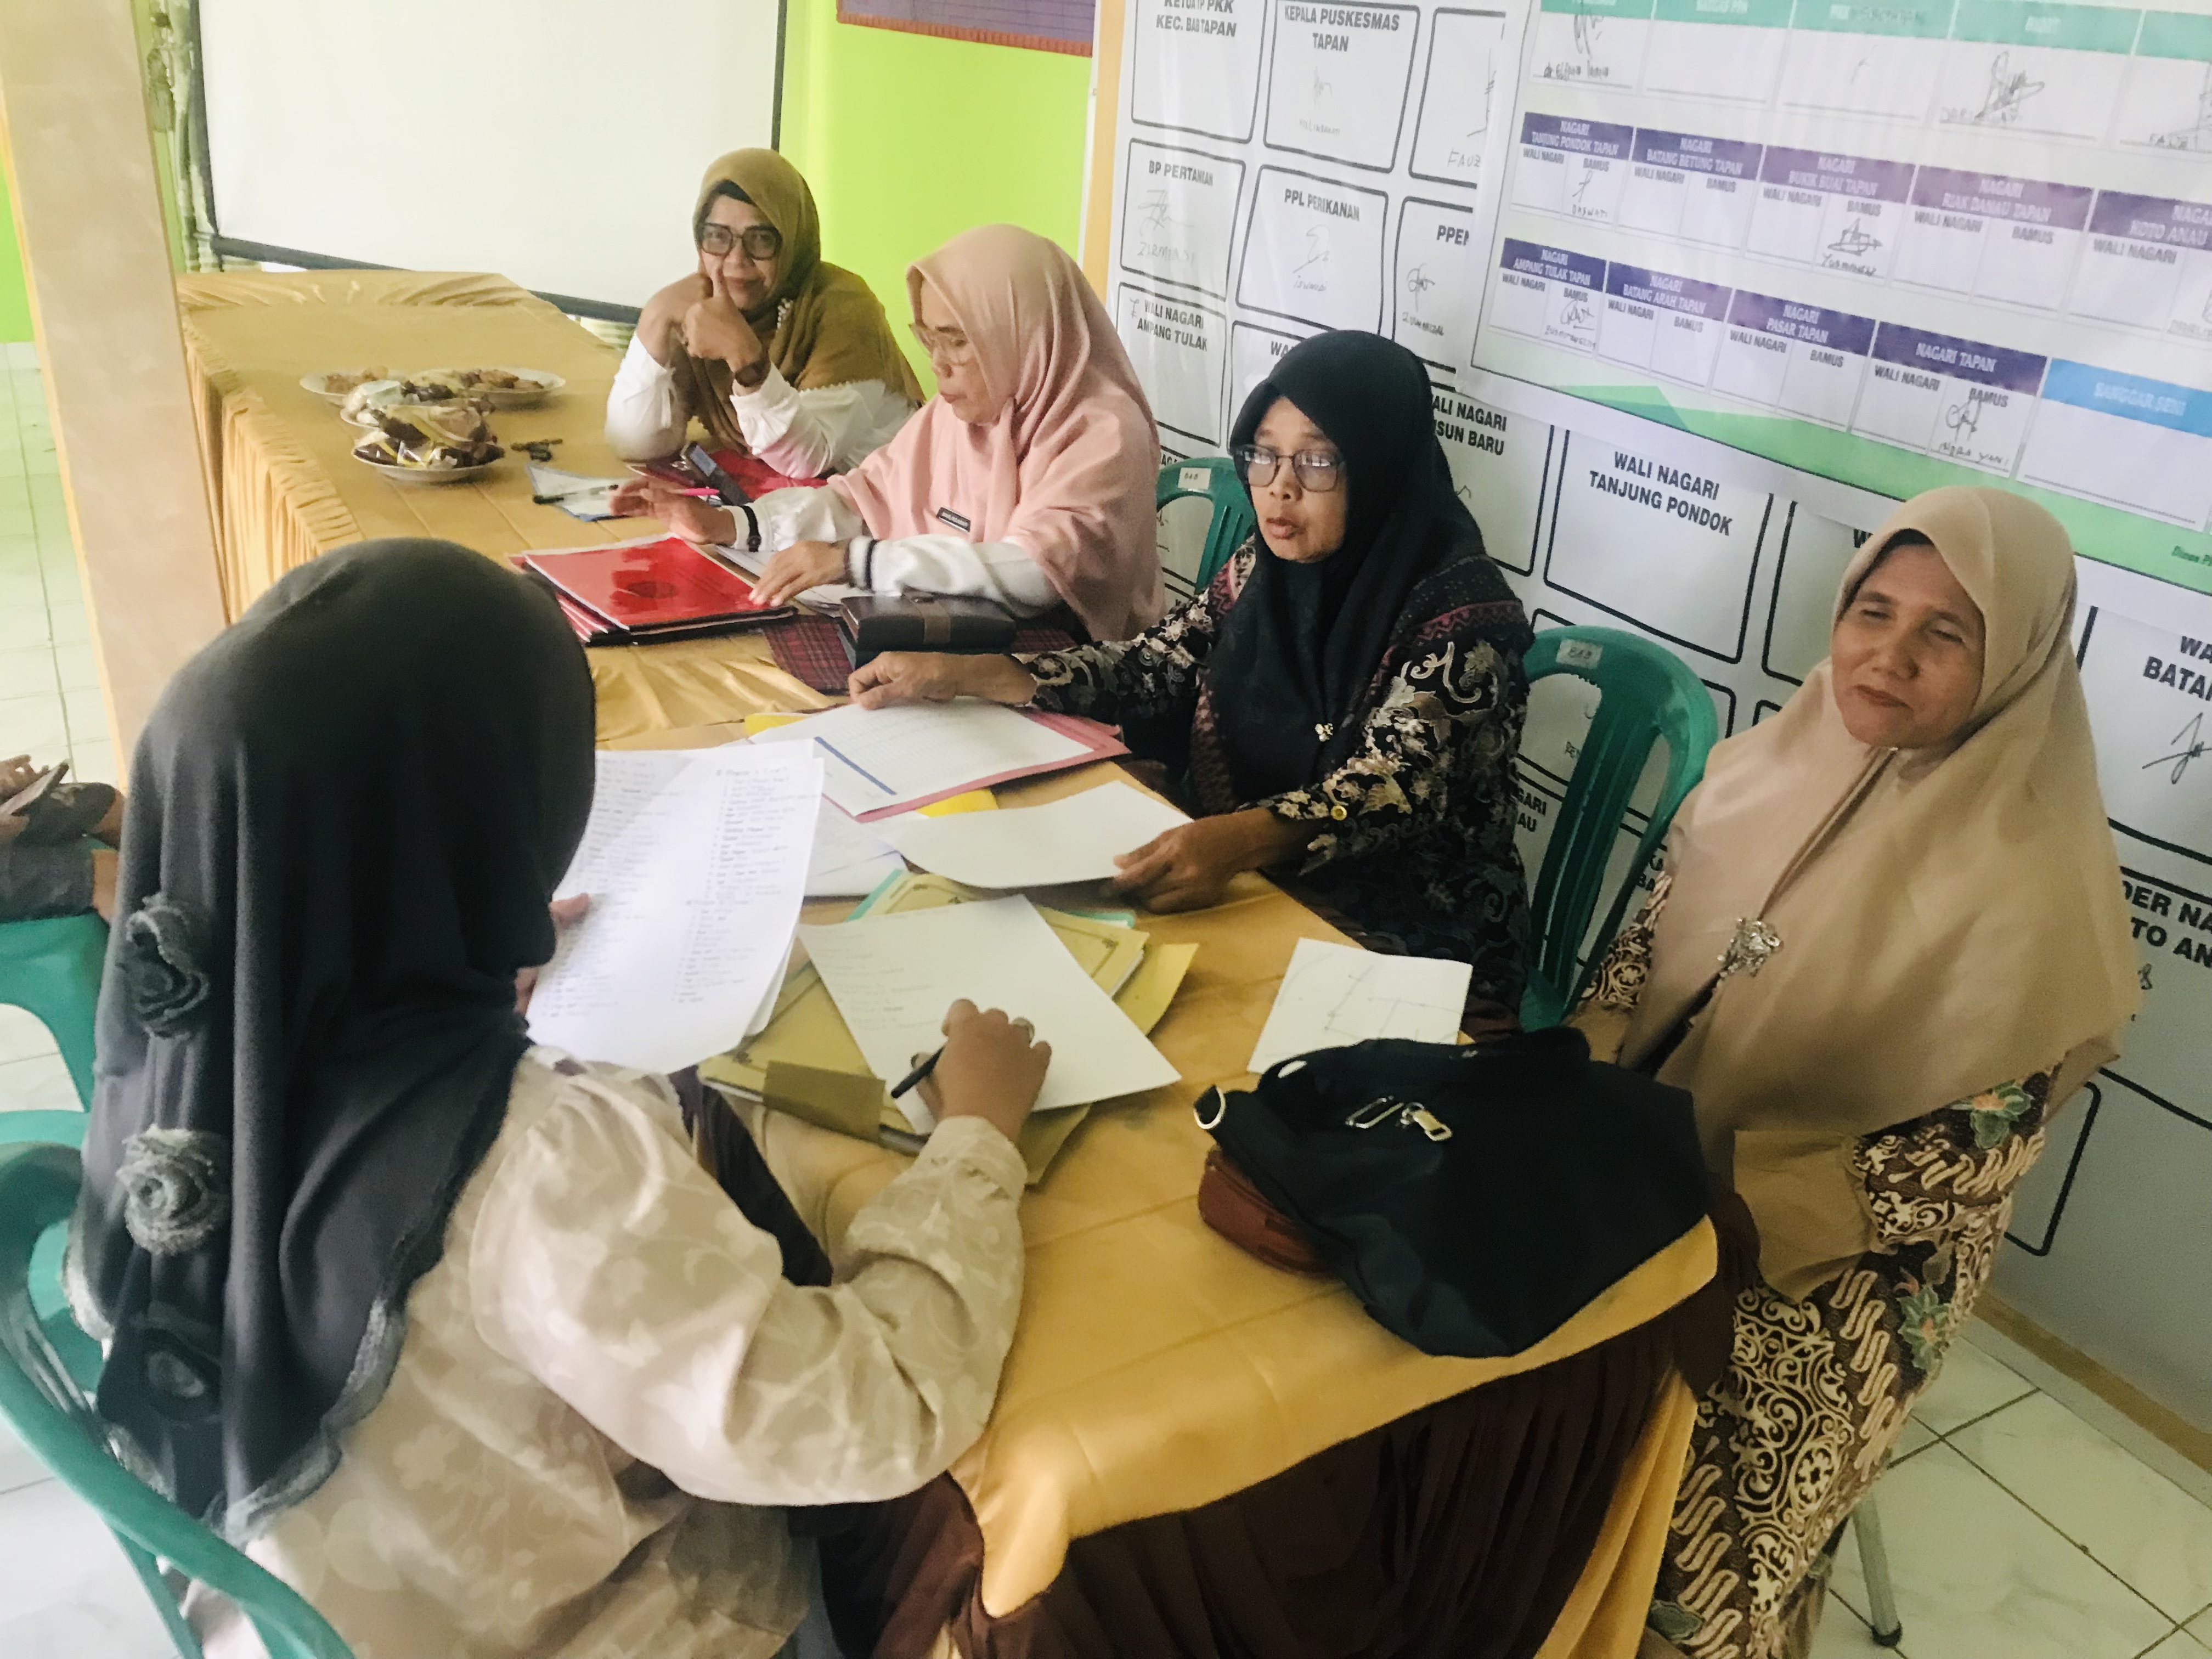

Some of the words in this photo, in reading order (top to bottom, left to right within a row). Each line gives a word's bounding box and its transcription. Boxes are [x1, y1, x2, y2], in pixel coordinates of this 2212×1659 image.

[1207, 0, 1234, 13] PKK
[1285, 5, 1317, 24] KEPALA
[1321, 8, 1400, 31] PUSKESMAS
[1156, 14, 1183, 30] KEC.
[1200, 19, 1237, 37] TAPAN
[1312, 32, 1349, 52] TAPAN
[1560, 121, 1590, 136] NAGARI
[1679, 137, 1713, 154] NAGARI
[1447, 148, 1481, 167] FAUZ
[1285, 188, 1305, 206] PPL
[1307, 194, 1360, 221] PERIKANAN
[2172, 205, 2212, 226] NAGA
[1541, 249, 1568, 266] NAGARI
[2094, 238, 2125, 255] WALI
[2128, 244, 2178, 265] NAGARI
[1502, 273, 1519, 285] WALI
[1521, 277, 1546, 292] NAGARI
[1650, 275, 1683, 292] NAGARI
[1608, 299, 1627, 312] WALI
[1628, 304, 1655, 320] NAGARI
[1623, 284, 1653, 301] BATANG
[1653, 292, 1677, 308] ARAH
[1678, 297, 1707, 314] TAPAN
[1144, 300, 1163, 317] WALI
[1165, 307, 1204, 329] NAGARI
[1674, 316, 1703, 332] BAMUS
[1783, 304, 1821, 324] NAGARI
[1137, 318, 1171, 340] AMPANG
[1174, 330, 1207, 352] TULAK
[1730, 330, 1753, 345] WALI
[1754, 336, 1788, 353] NAGARI
[1766, 318, 1797, 336] PASAR
[1798, 325, 1829, 343] TAPAN
[1810, 349, 1844, 368] BAMUS
[1916, 342, 1957, 364] NAGARI
[1959, 352, 1997, 373] TAPAN
[1874, 364, 1900, 382] WALI
[1901, 371, 1940, 392] NAGARI
[1968, 387, 2009, 408] BAMUS
[1432, 396, 1453, 415] ALI
[1457, 402, 1508, 432] NAGARI
[1468, 430, 1505, 456] BARU
[1615, 452, 1652, 478] WALI
[1657, 465, 1720, 500] NAGARI
[1590, 470, 1662, 510] TANJUNG
[1666, 496, 1733, 536] PONDOK
[2131, 917, 2167, 947] TO
